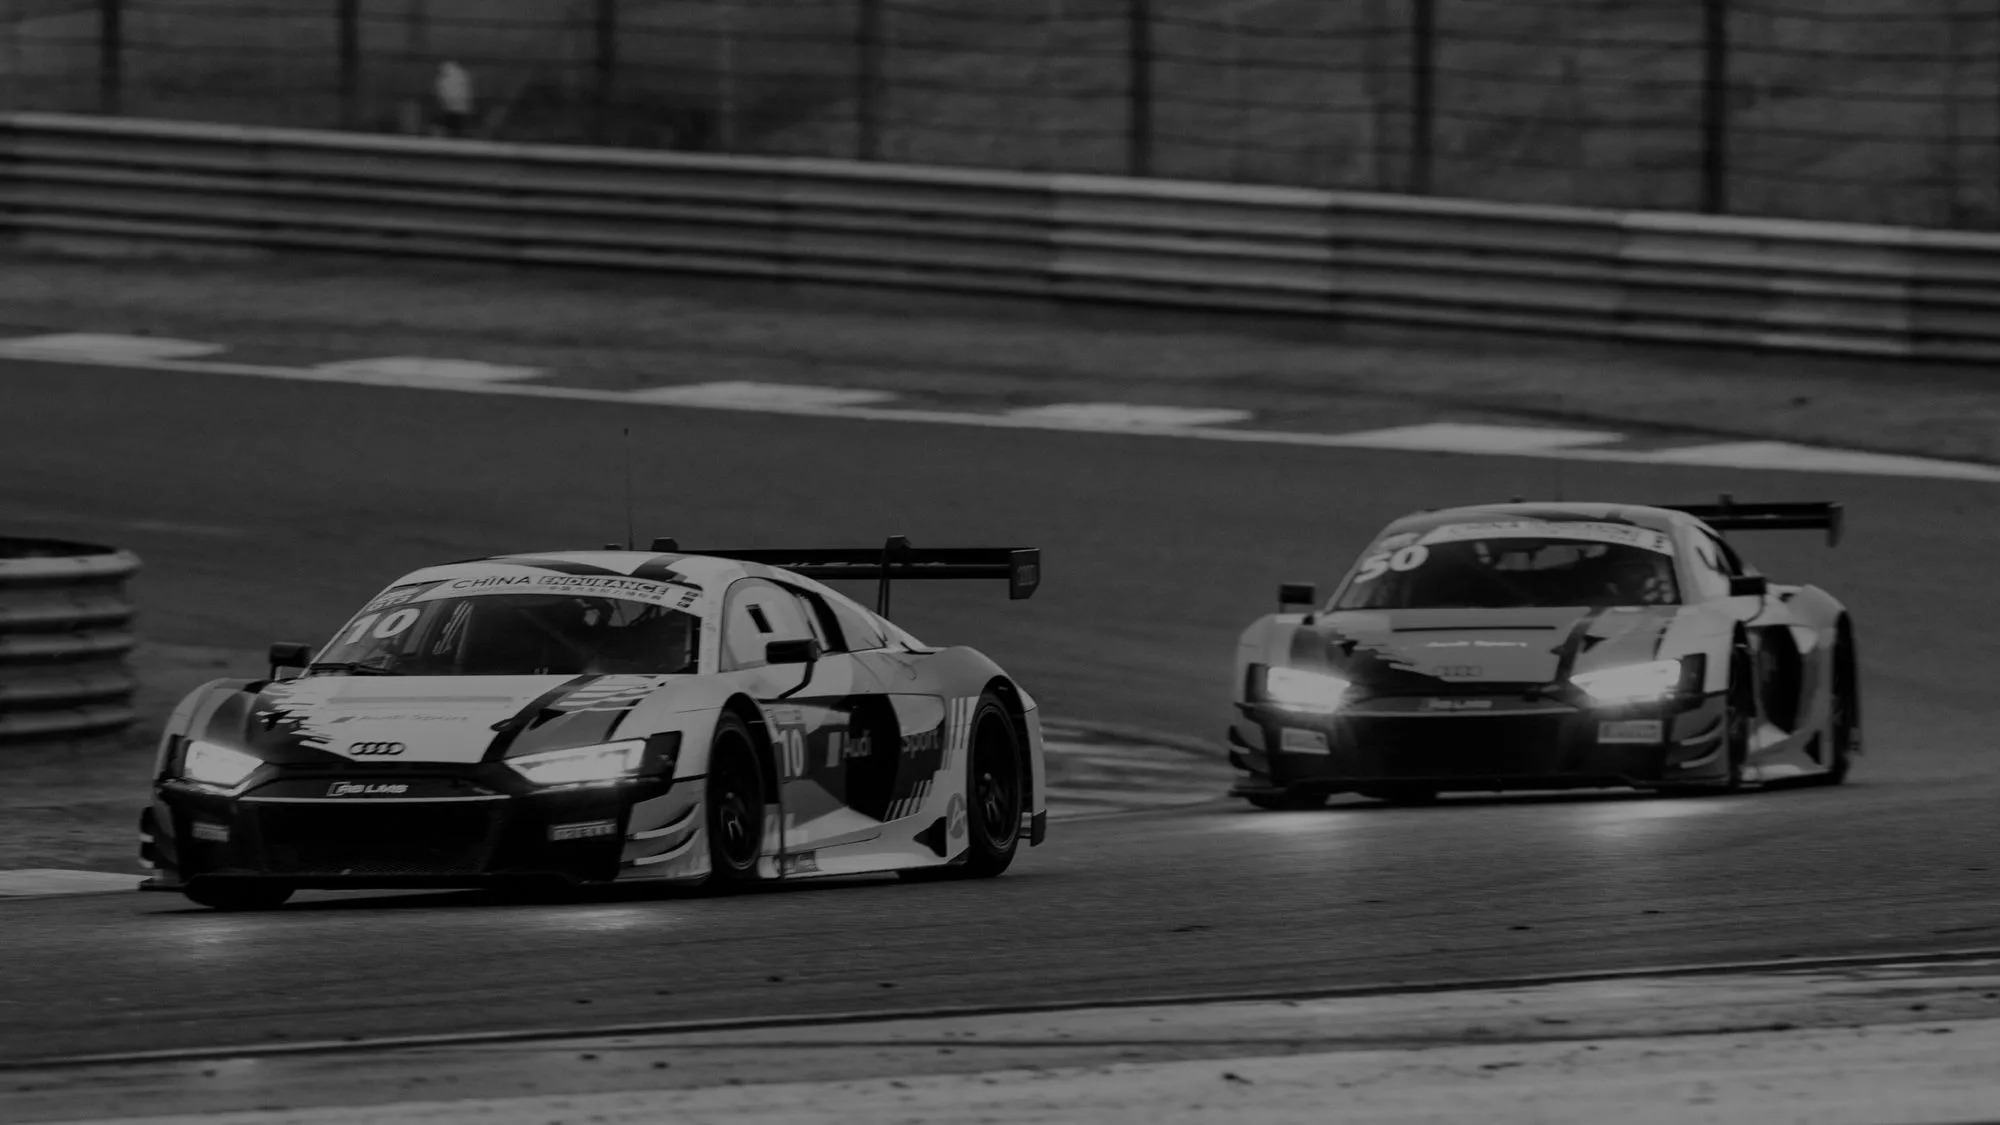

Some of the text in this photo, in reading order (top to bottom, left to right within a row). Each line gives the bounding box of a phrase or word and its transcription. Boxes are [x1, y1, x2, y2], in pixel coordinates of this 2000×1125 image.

[1357, 545, 1429, 583] 50
[452, 575, 669, 595] CHINA ENDURANCE
[347, 607, 420, 645] 10
[780, 729, 804, 777] 10
